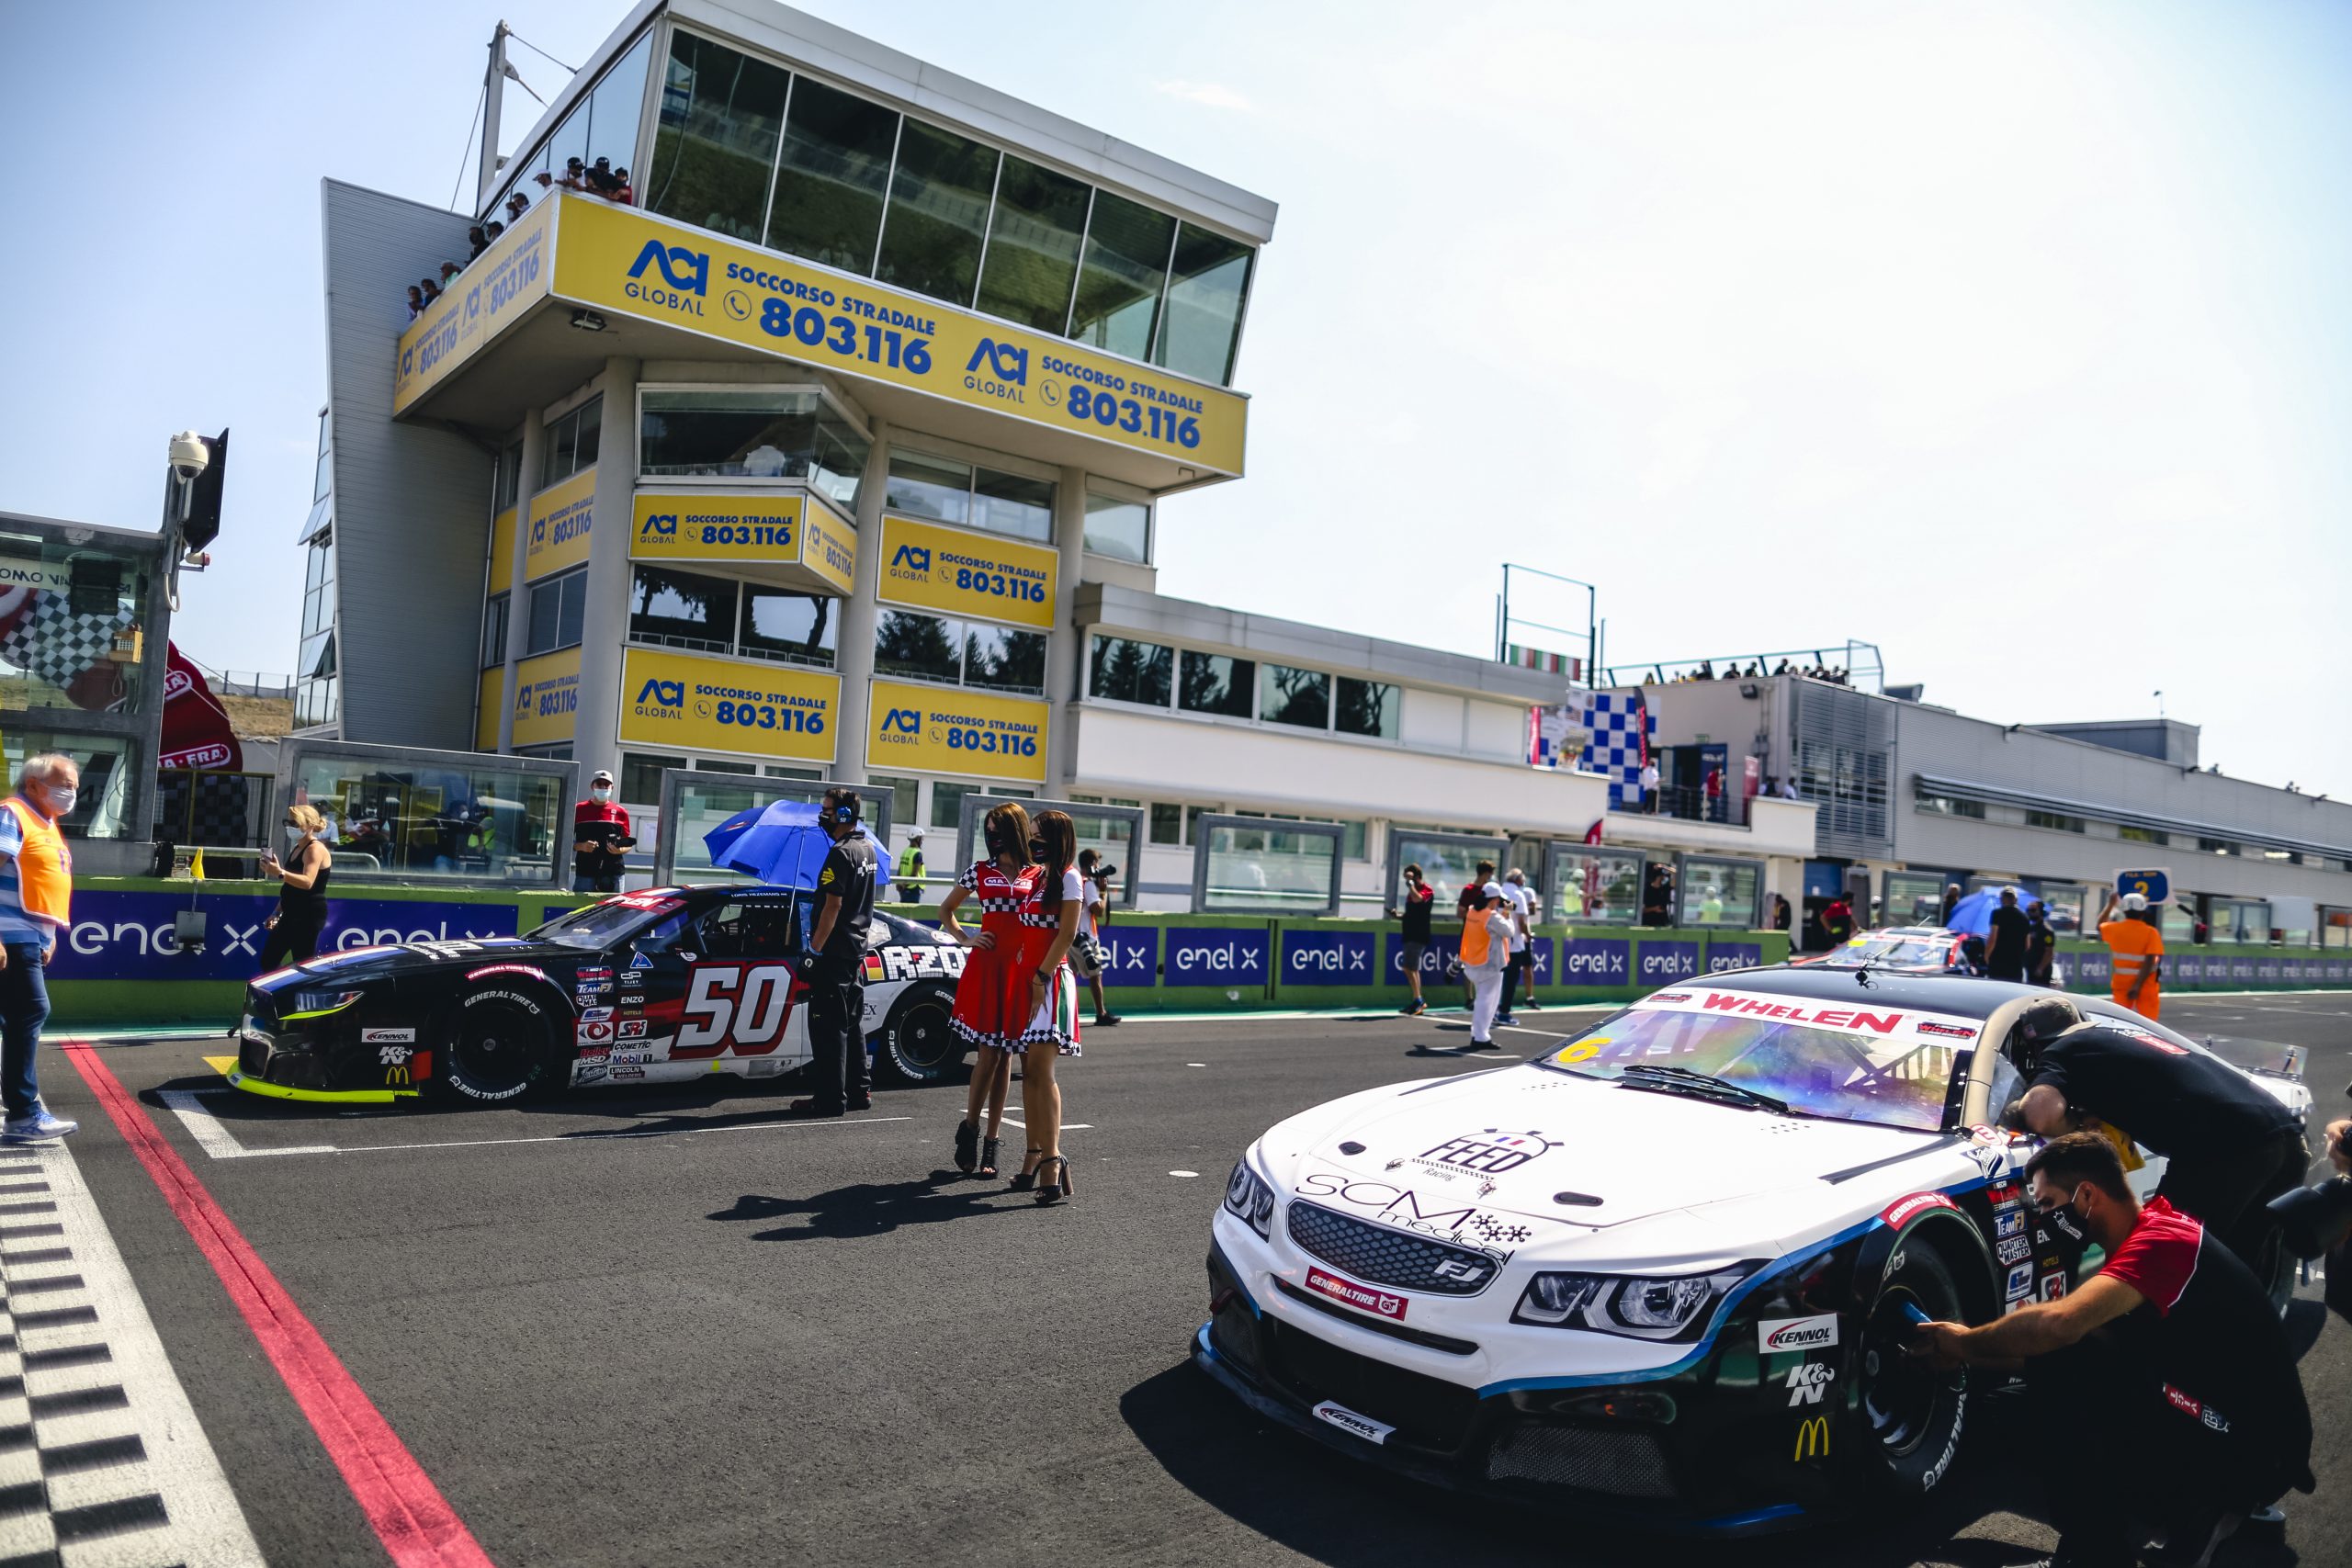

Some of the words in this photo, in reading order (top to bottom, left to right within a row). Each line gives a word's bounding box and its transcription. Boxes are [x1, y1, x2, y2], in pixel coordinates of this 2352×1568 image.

[491, 248, 539, 315] 803.116
[627, 239, 710, 297] ACI
[625, 282, 705, 317] GLOBAL
[727, 263, 835, 307] SOCCORSO
[842, 297, 935, 336] STRADALE
[420, 321, 458, 375] 803.116
[760, 298, 932, 375] 803.116
[966, 337, 1029, 386] ACI
[964, 376, 1024, 404] GLOBAL
[1042, 355, 1125, 391] SOCCORSO
[1130, 381, 1203, 414] STRADALE
[1067, 384, 1201, 448] 803.116
[553, 510, 592, 546] 803.116
[641, 514, 677, 535] ACI
[685, 515, 739, 524] SOCCORSO
[742, 516, 793, 525] STRADALE
[701, 525, 791, 546] 803.116
[891, 544, 931, 571] ACI
[939, 552, 994, 570] SOCCORSO
[998, 563, 1046, 581] STRADALE
[889, 569, 929, 583] GLOBAL
[956, 568, 1045, 603] 803.116
[538, 688, 577, 716] 803.116
[637, 679, 684, 707] ACI
[695, 684, 762, 701] SOCCORSO
[766, 694, 826, 709] STRADALE
[635, 705, 682, 720] GLOBAL
[716, 701, 824, 735] 803.116
[880, 708, 921, 734] ACI
[930, 713, 985, 727] SOCCORSO
[989, 720, 1038, 734] STRADALE
[879, 733, 919, 746] GLOBAL
[946, 728, 1036, 757] 803.116
[223, 923, 259, 956] x
[1126, 947, 1146, 969] x
[1177, 942, 1234, 970] enel
[1241, 948, 1259, 970] x
[1293, 944, 1344, 970] enel
[1350, 950, 1365, 970] x
[1569, 947, 1608, 973] enel
[1611, 954, 1623, 973] x
[1644, 947, 1678, 974] enel
[1681, 955, 1693, 974] x
[1711, 948, 1745, 971] enel
[464, 991, 508, 1007] GENERAL
[509, 993, 532, 1007] TIRE
[675, 965, 792, 1047] 50
[1702, 993, 1904, 1033] WHELEN
[613, 1055, 640, 1064] Mobil
[1558, 1037, 1611, 1064] 6
[1419, 1137, 1533, 1174] FEED
[1422, 1168, 1456, 1181] Racing
[1295, 1174, 1477, 1230] SCM
[1377, 1210, 1515, 1266] medical
[1772, 1327, 1830, 1345] KENNOL
